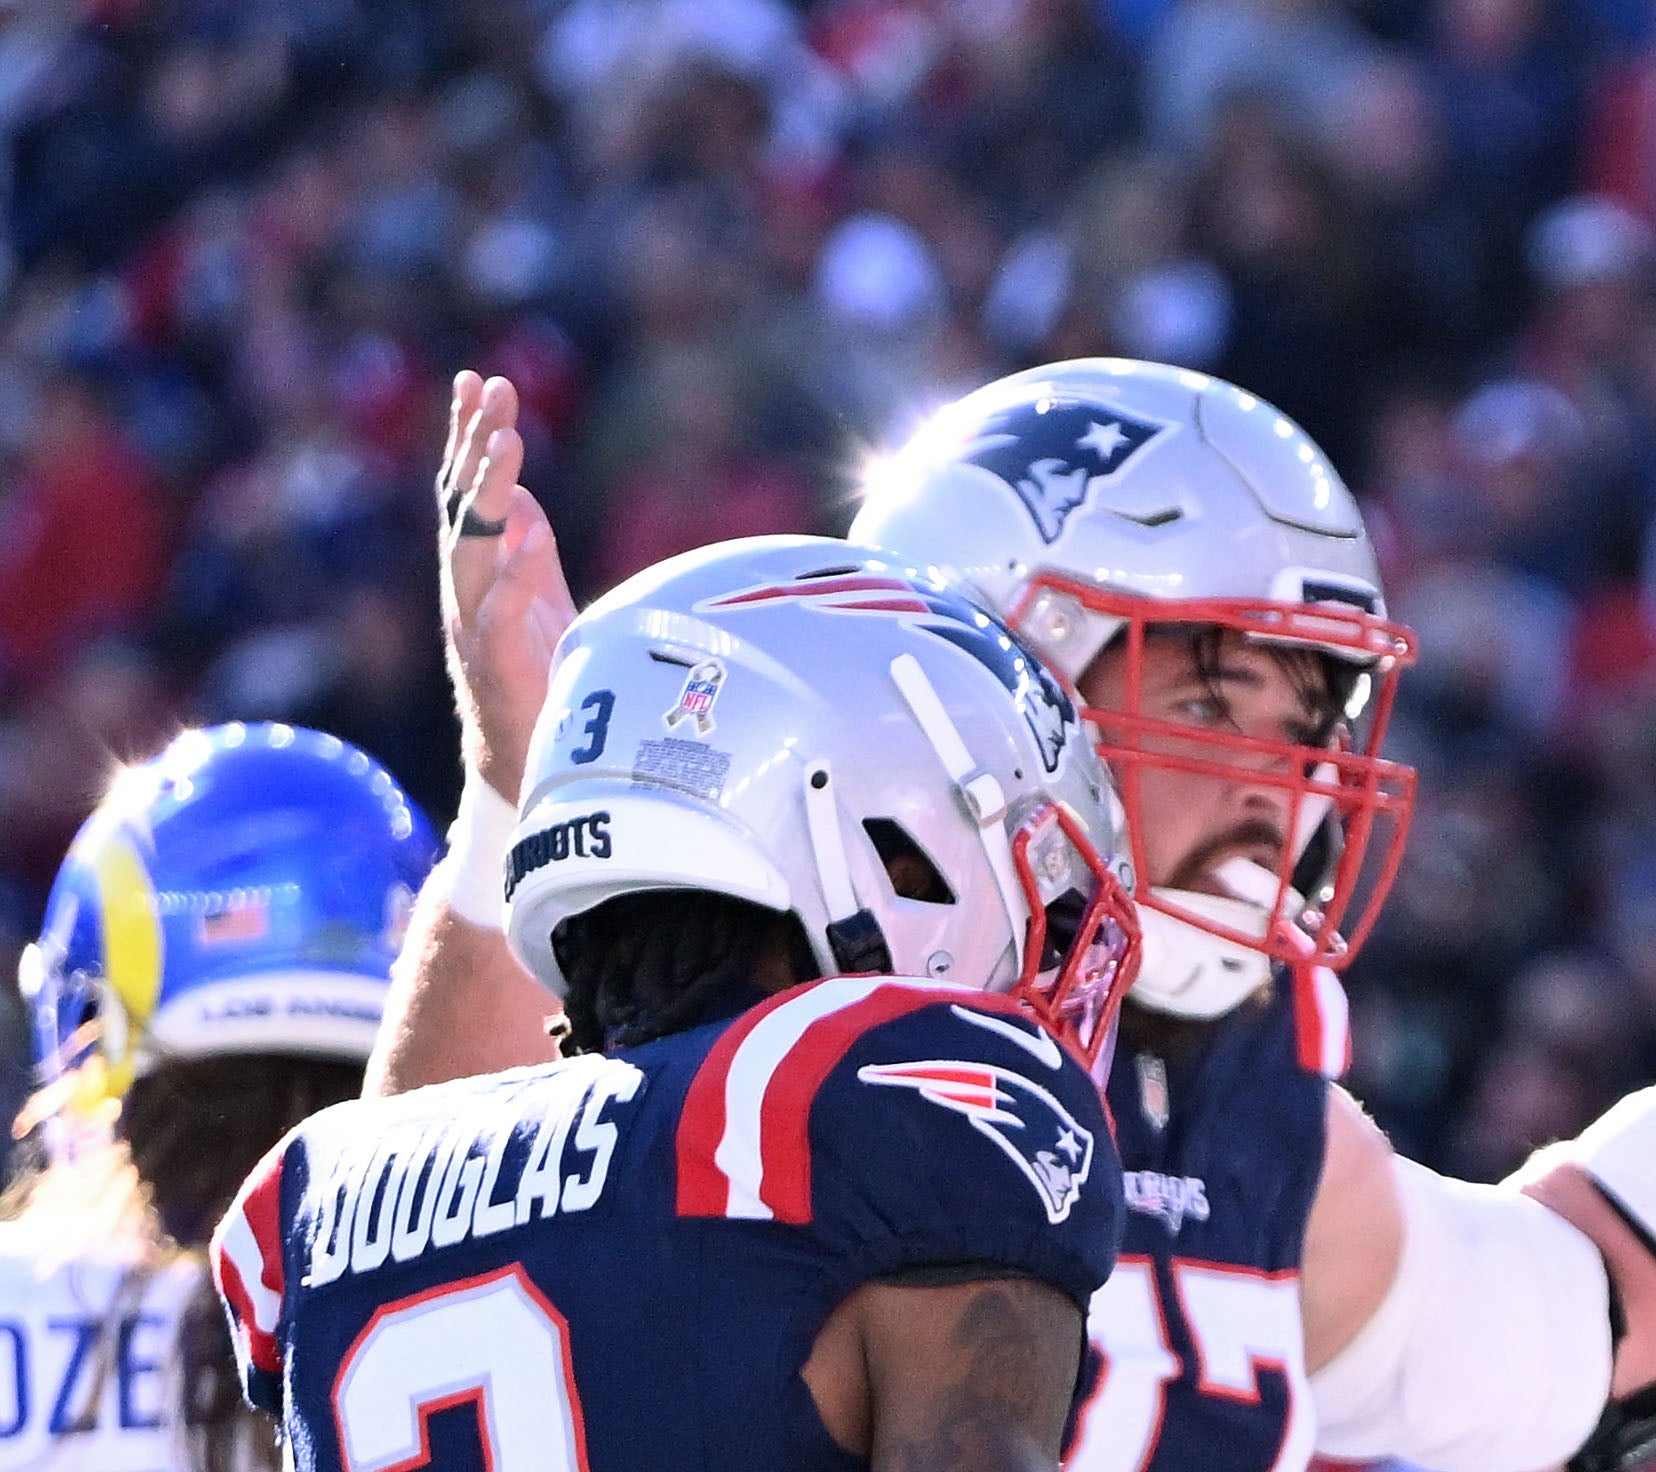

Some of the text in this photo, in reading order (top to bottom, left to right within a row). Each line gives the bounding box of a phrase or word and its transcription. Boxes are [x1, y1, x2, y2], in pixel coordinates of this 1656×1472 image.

[570, 688, 617, 765] 3
[683, 691, 711, 713] NFL
[300, 1066, 645, 1289] DOUGLAS
